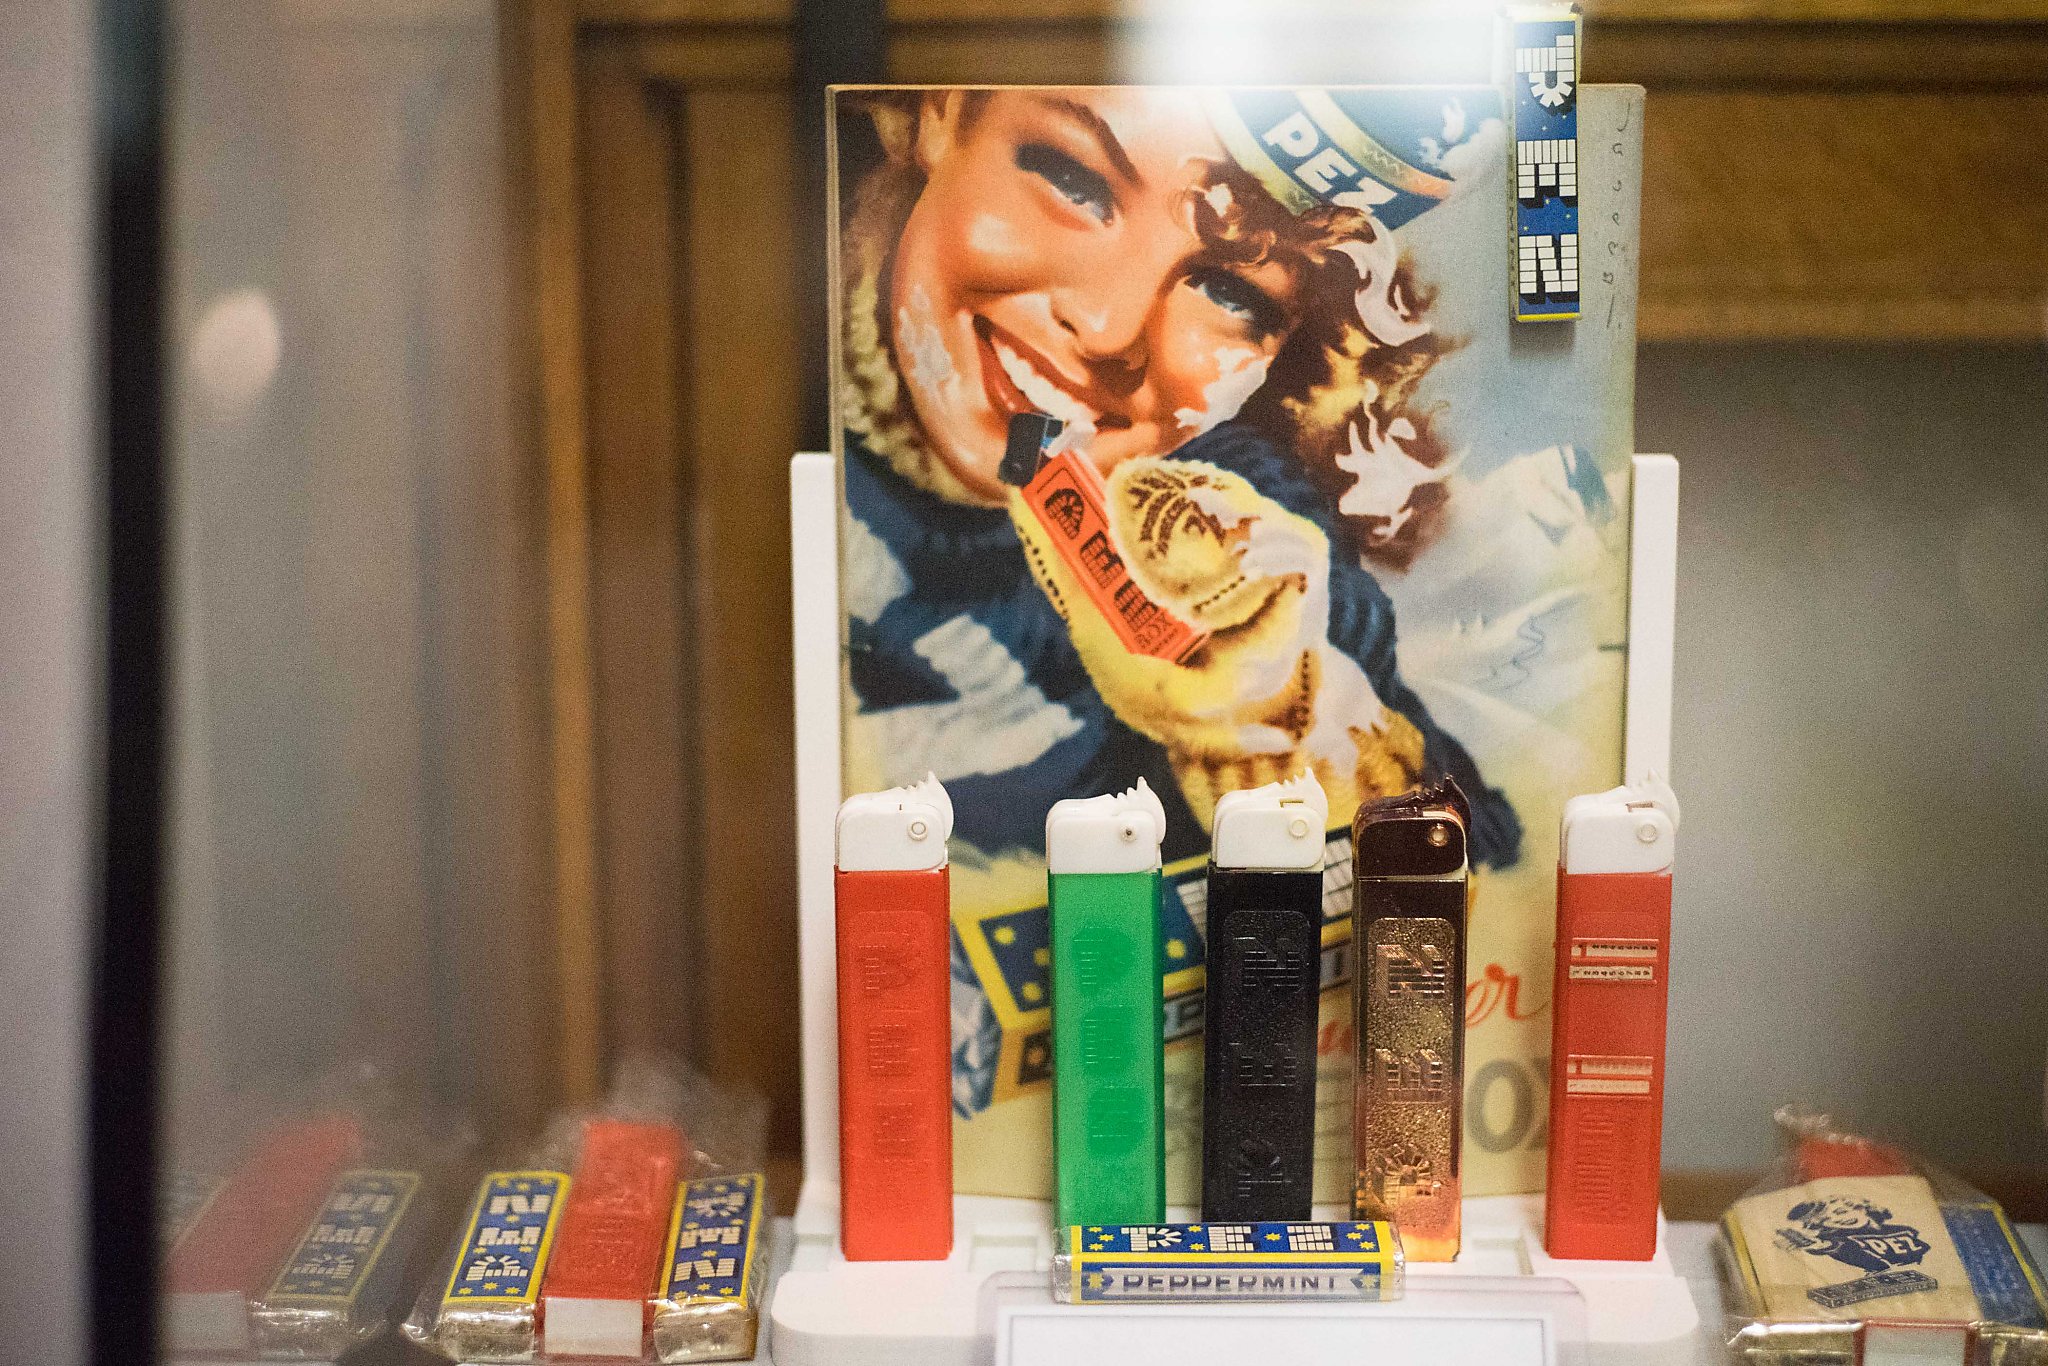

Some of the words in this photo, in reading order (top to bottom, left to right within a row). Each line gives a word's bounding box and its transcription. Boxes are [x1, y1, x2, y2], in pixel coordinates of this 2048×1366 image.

[1261, 110, 1398, 215] PEZ
[1515, 34, 1579, 296] PEZ
[1044, 488, 1159, 634] PEZ
[1374, 943, 1447, 1207] PEZ
[291, 1192, 394, 1280] PEZ
[465, 1194, 552, 1282] PEZ
[674, 1191, 747, 1283] PEZ
[1120, 1225, 1335, 1252] PEZ
[1867, 1235, 1922, 1255] PEZ
[1122, 1272, 1340, 1293] PEPPERMINT
